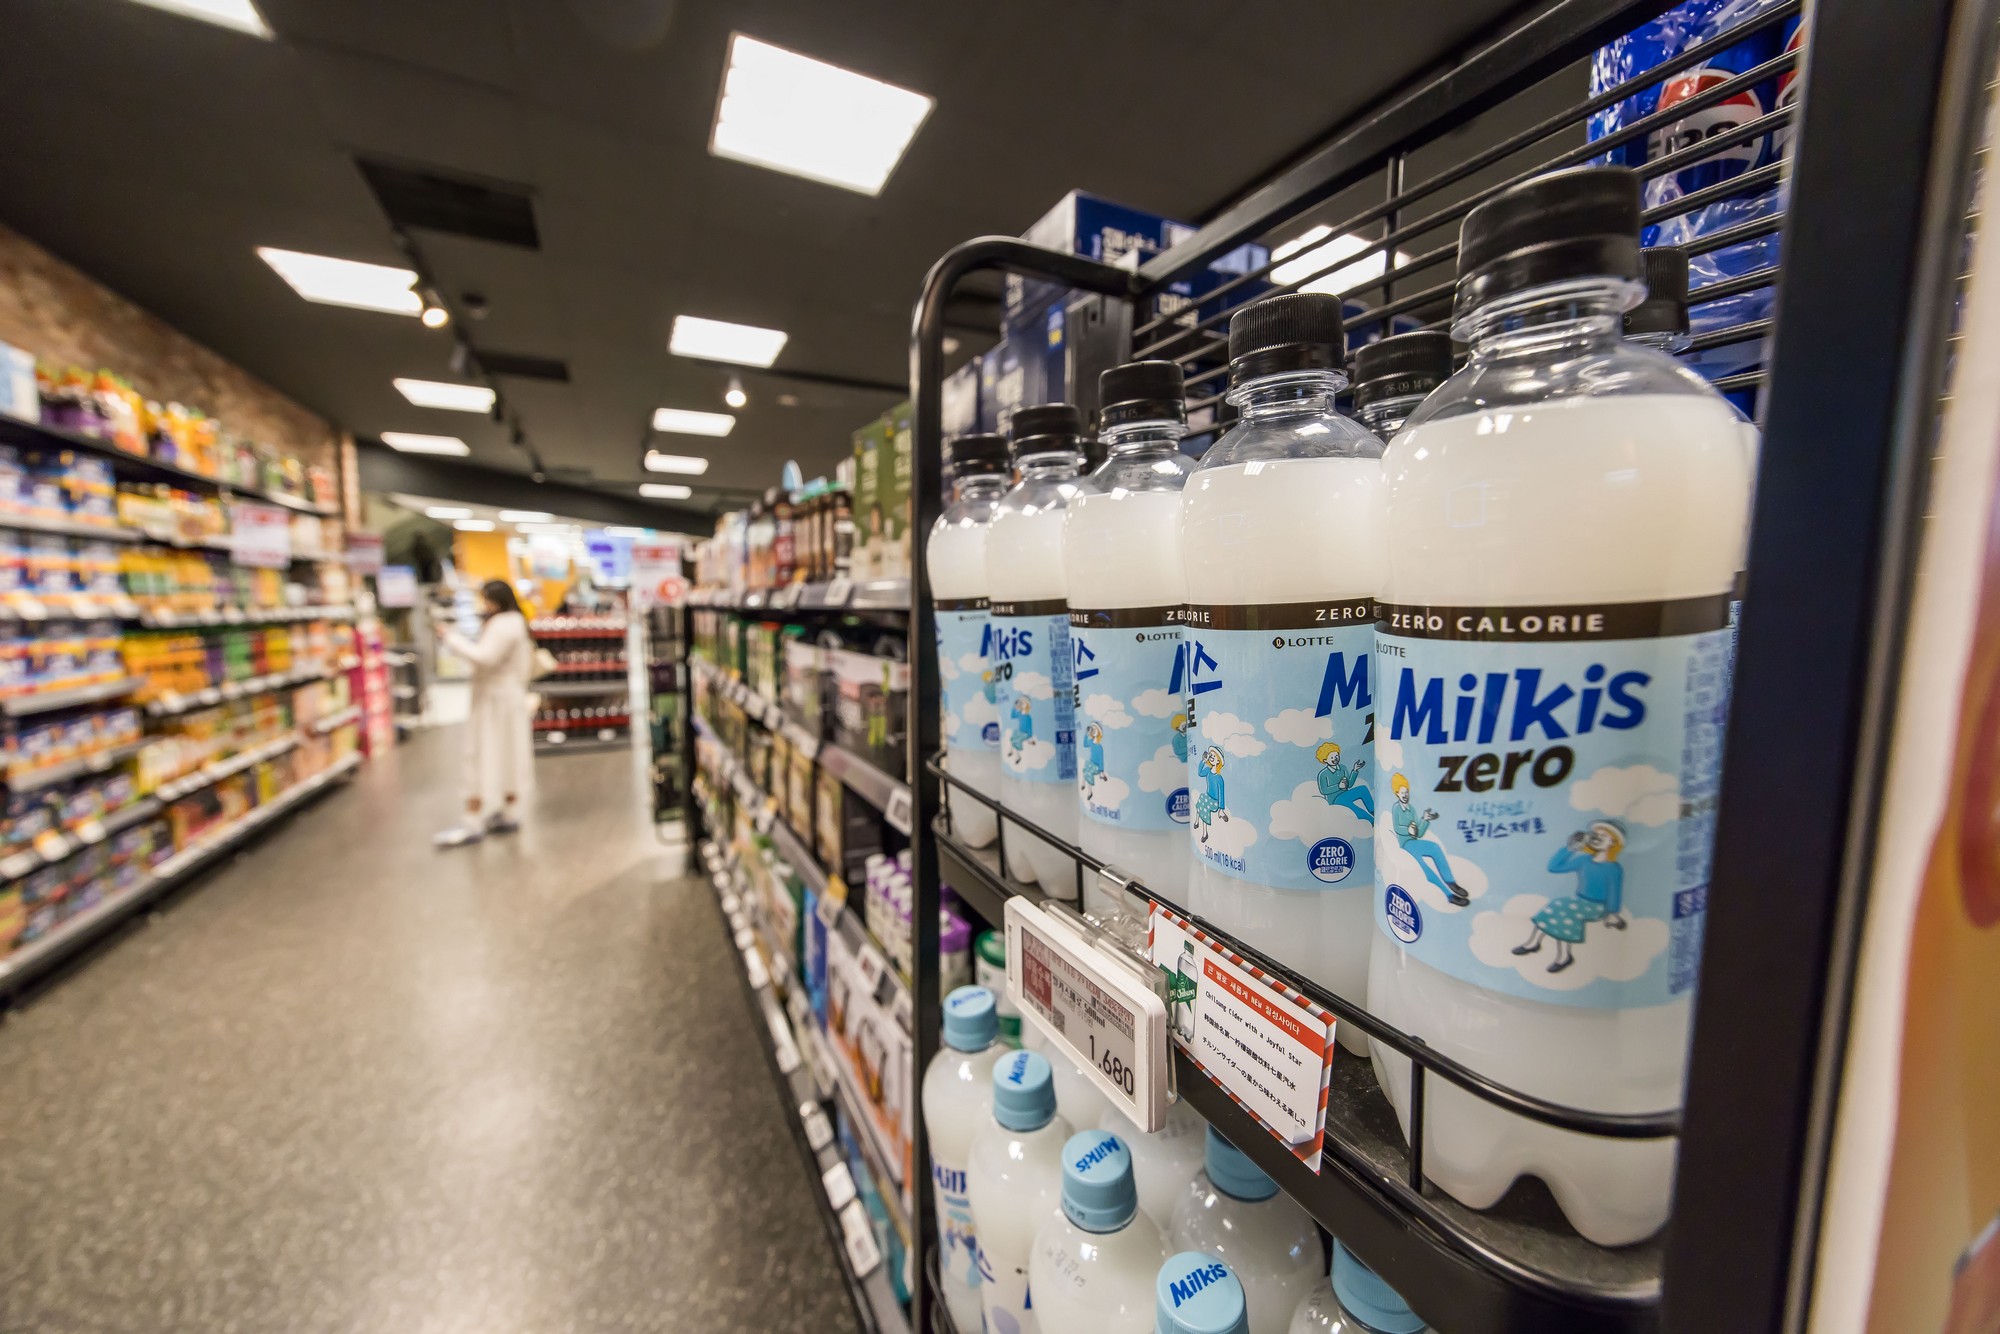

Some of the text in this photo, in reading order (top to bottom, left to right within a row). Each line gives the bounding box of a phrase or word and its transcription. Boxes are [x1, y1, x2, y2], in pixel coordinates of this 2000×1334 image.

[1166, 610, 1184, 621] ZE
[1183, 610, 1210, 623] LORIE
[1316, 606, 1367, 621] ZERO
[1391, 612, 1605, 634] ZERO CALORIE
[1147, 631, 1182, 642] LOTTE
[1288, 636, 1334, 648] LOTTE
[1379, 642, 1406, 658] LOTTE
[1390, 662, 1653, 745] Milkis
[1433, 744, 1575, 793] zero
[1175, 794, 1189, 804] ZER
[1457, 816, 1547, 843] 밀키스제로
[1315, 856, 1348, 866] CALORIE
[1319, 845, 1345, 858] ZERO
[1229, 855, 1246, 874] kcal)
[1388, 903, 1416, 928] CALORIE
[1391, 892, 1412, 916] ZERO
[1084, 1002, 1106, 1028] 500ml
[1230, 980, 1249, 1000] 새롭게
[1250, 995, 1263, 1009] NEW
[1264, 1004, 1300, 1036] 칠성사이다
[1205, 990, 1227, 1013] Chilsung
[1228, 1008, 1243, 1023] Cider
[1244, 1020, 1258, 1035] with
[1266, 1036, 1286, 1056] Joyful
[1288, 1052, 1303, 1067] Star
[1088, 1034, 1135, 1096] 1,680
[1075, 1136, 1121, 1173] Milkis
[1169, 1263, 1228, 1309] Milkis
